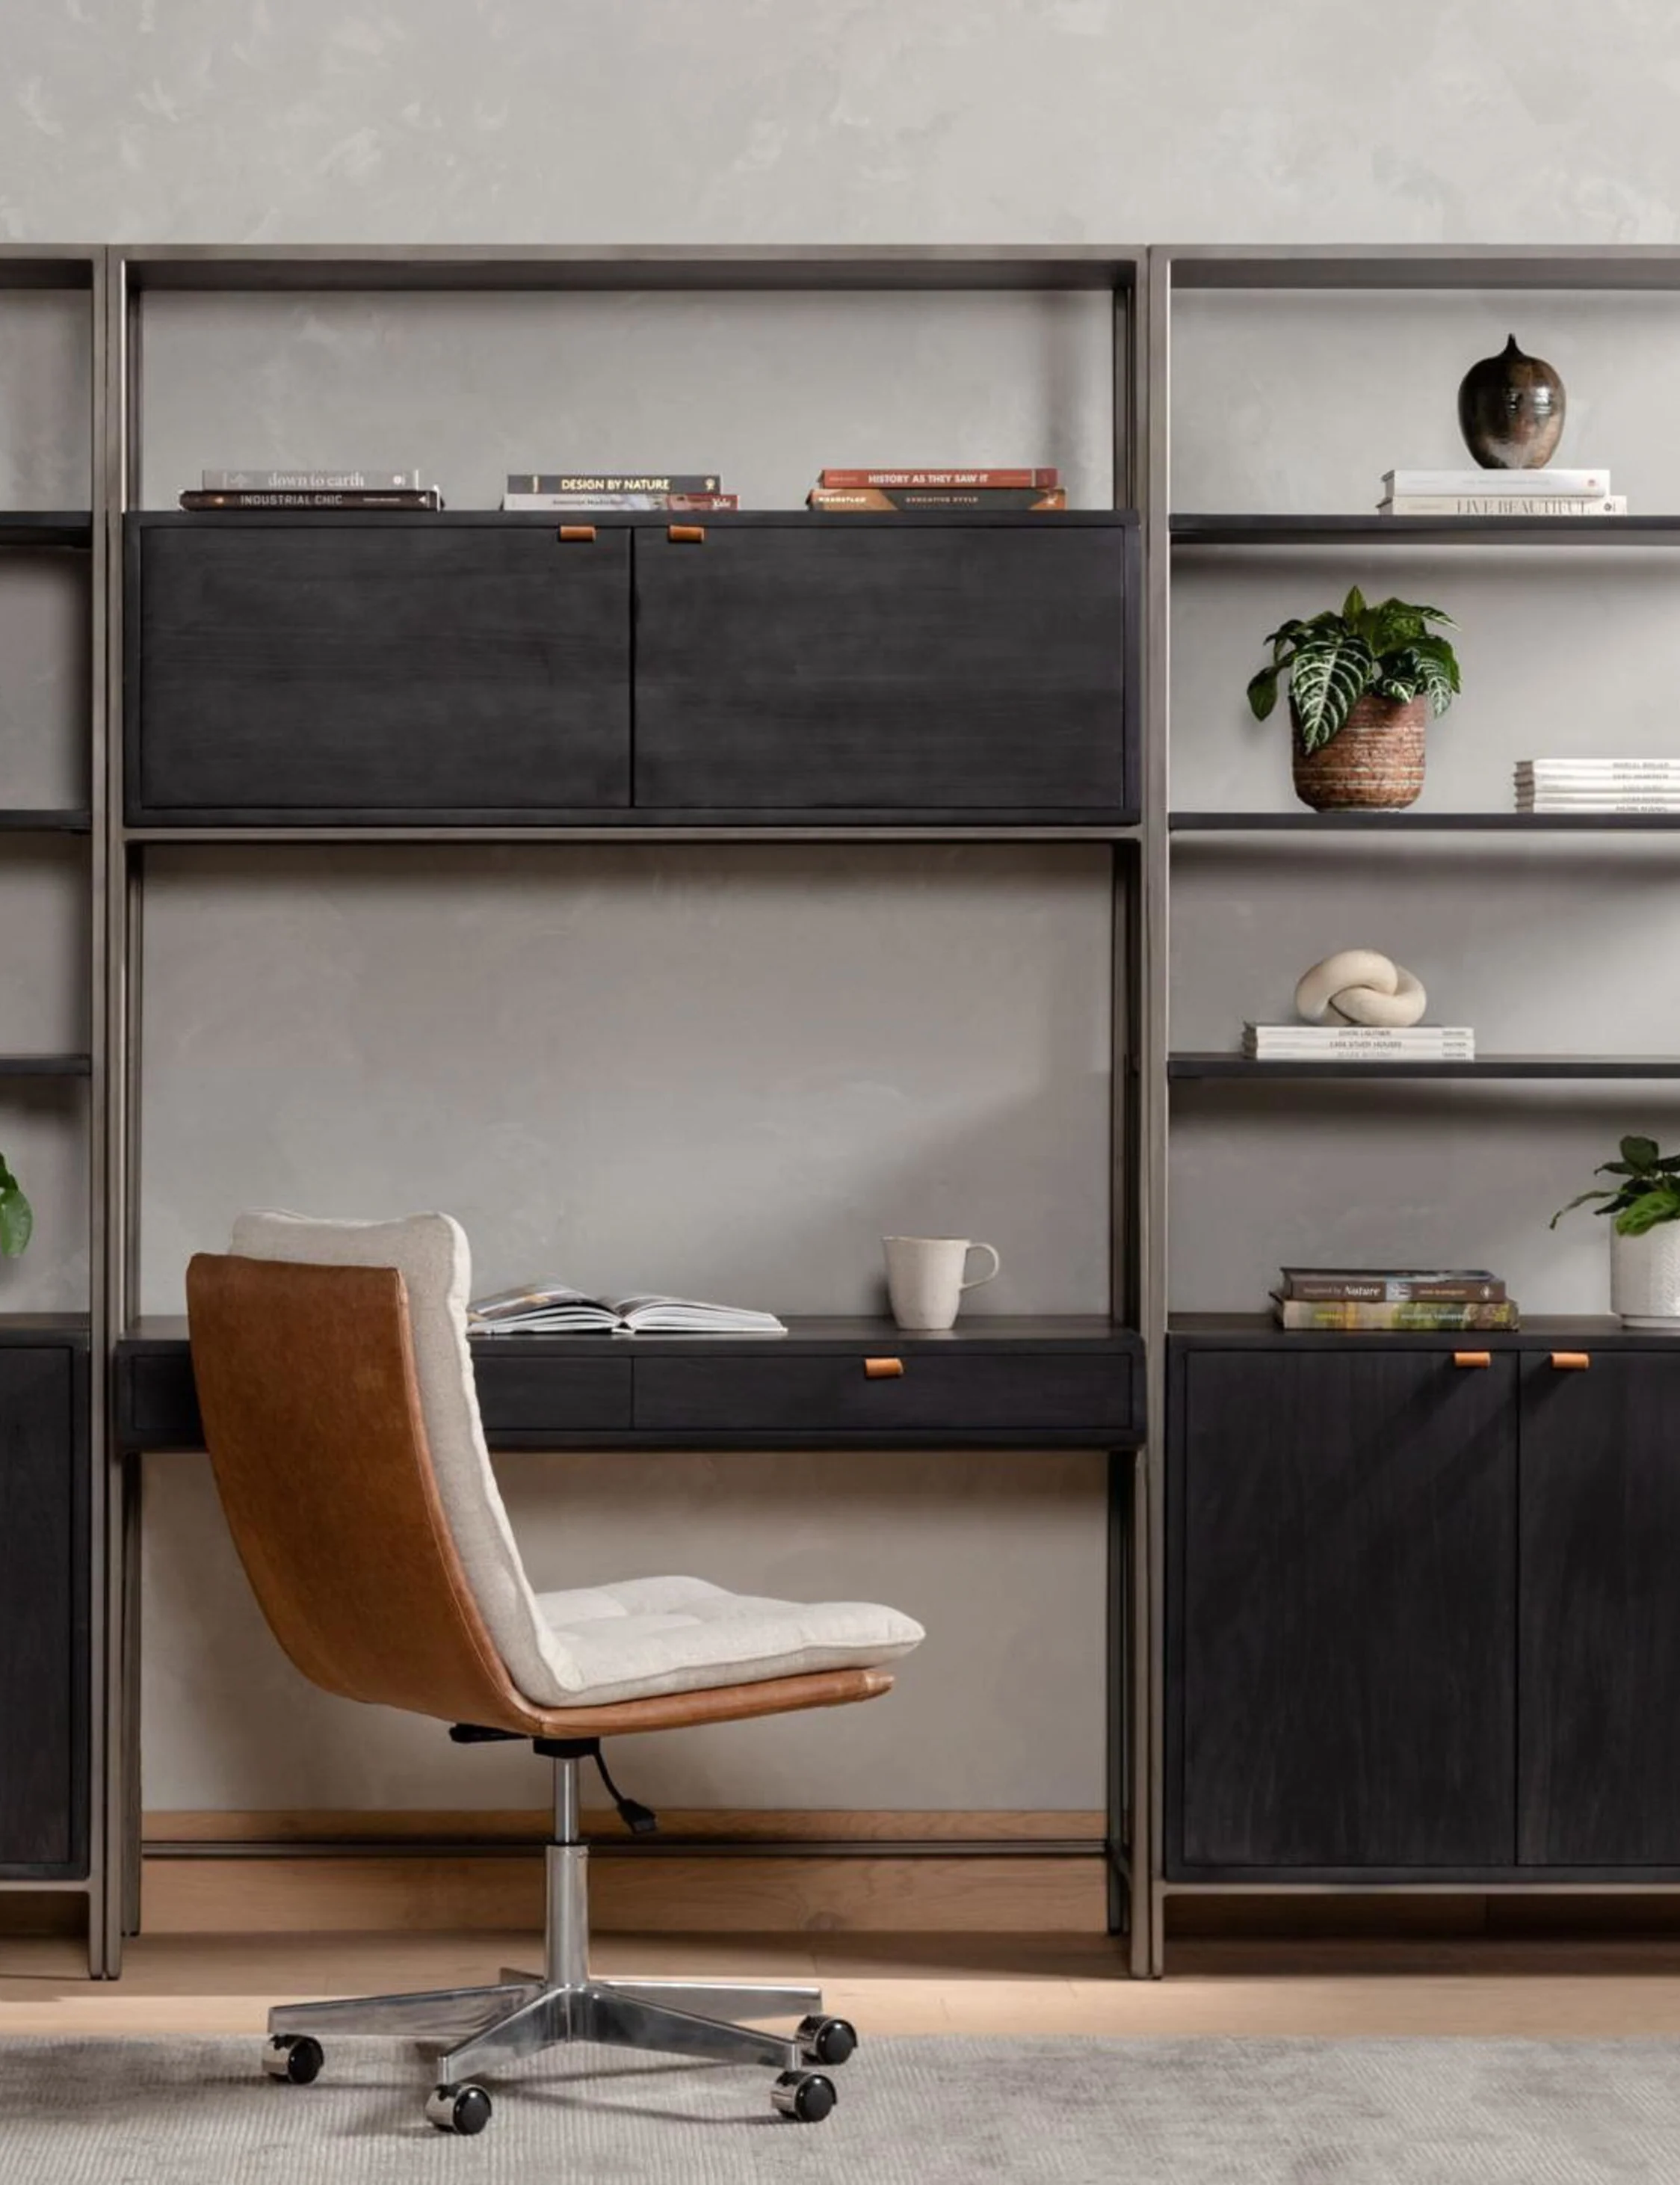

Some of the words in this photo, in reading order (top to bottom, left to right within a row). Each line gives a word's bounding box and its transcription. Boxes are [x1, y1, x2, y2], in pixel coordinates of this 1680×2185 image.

[268, 472, 307, 487] down
[310, 473, 324, 487] to
[327, 472, 365, 487] earth
[561, 478, 605, 490] DESIGN
[608, 478, 623, 490] BY
[623, 478, 670, 490] NATURE
[868, 473, 910, 484] HISTORY
[912, 473, 926, 484] AS
[928, 473, 952, 484] THEY
[954, 473, 978, 484] SAW
[979, 473, 989, 484] IT
[240, 494, 312, 505] INDUSTRIAL
[315, 494, 343, 505] CHIC
[1457, 499, 1494, 514] LIVE
[1498, 499, 1590, 514] BEAUTIFUL
[1344, 1284, 1381, 1297] Nature
